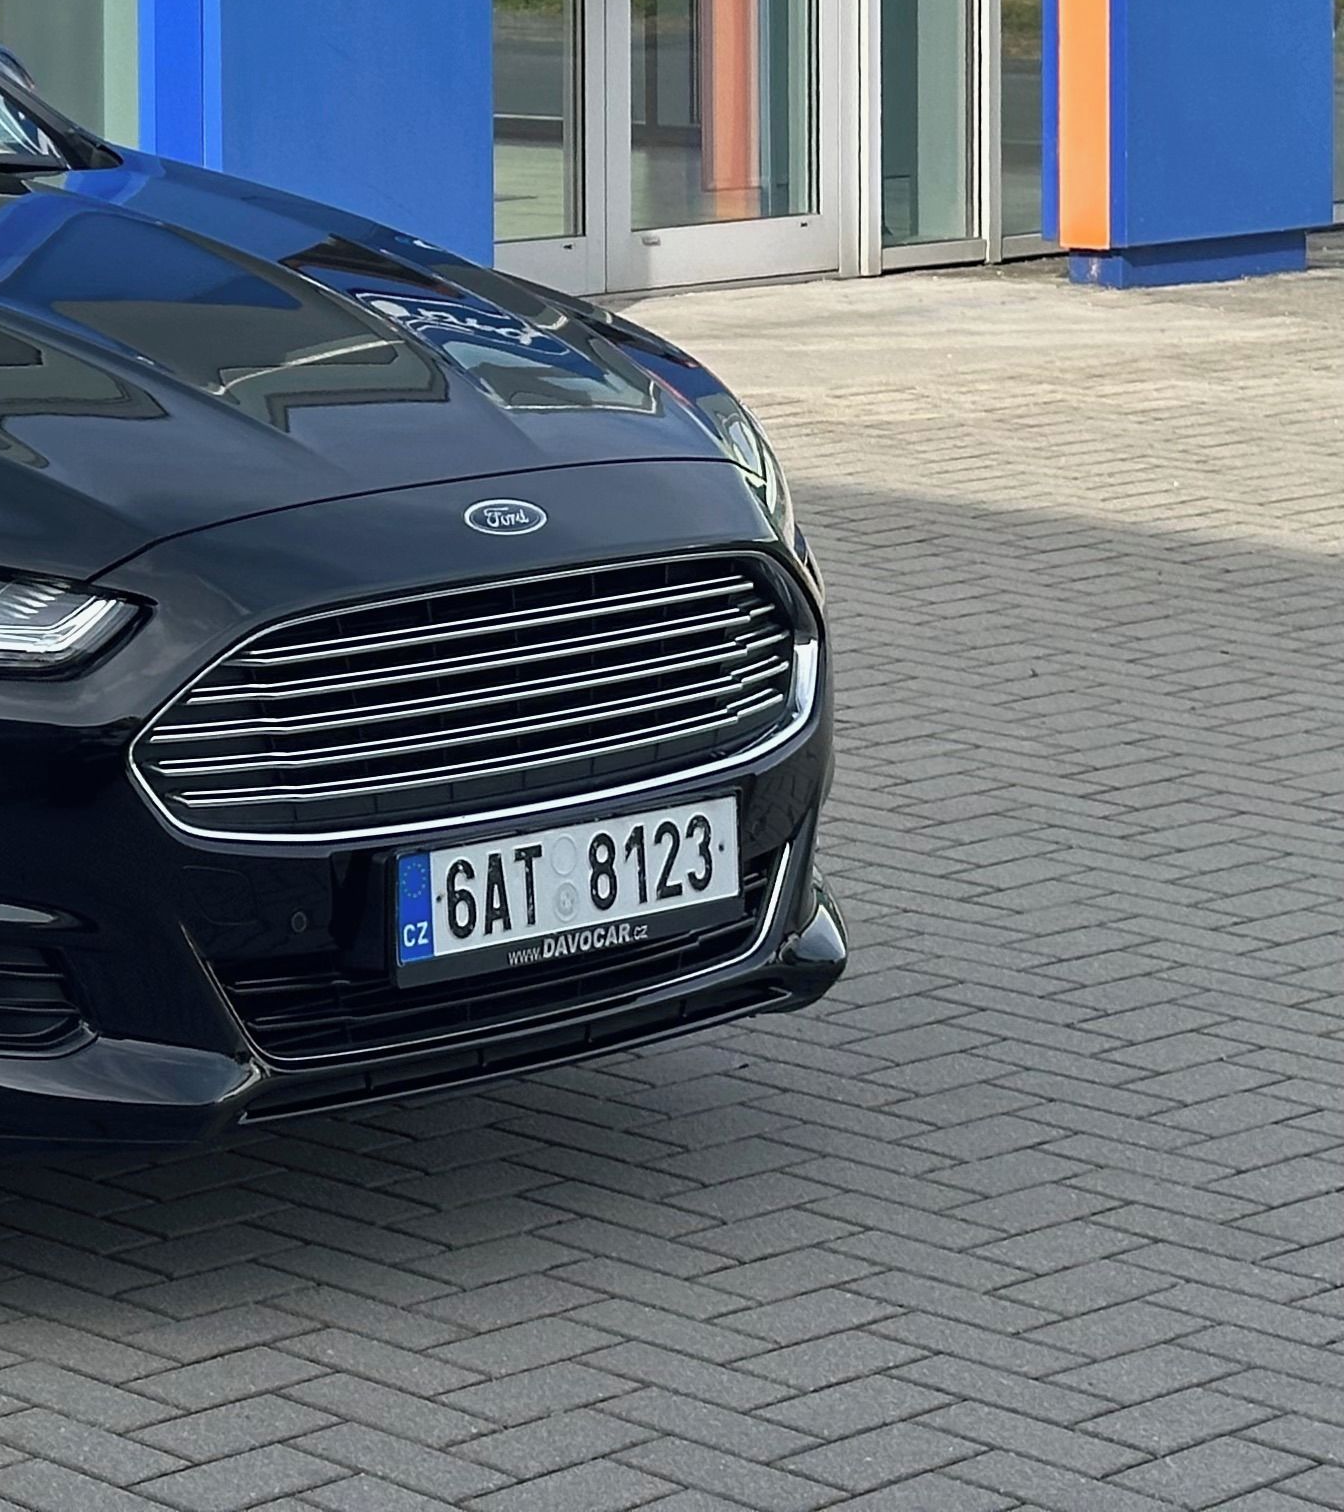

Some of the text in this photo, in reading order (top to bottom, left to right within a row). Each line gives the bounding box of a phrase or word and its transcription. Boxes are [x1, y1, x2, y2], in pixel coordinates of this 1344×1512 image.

[483, 507, 530, 528] Ford
[445, 814, 713, 939] 6AT 8123
[402, 920, 429, 948] CZ
